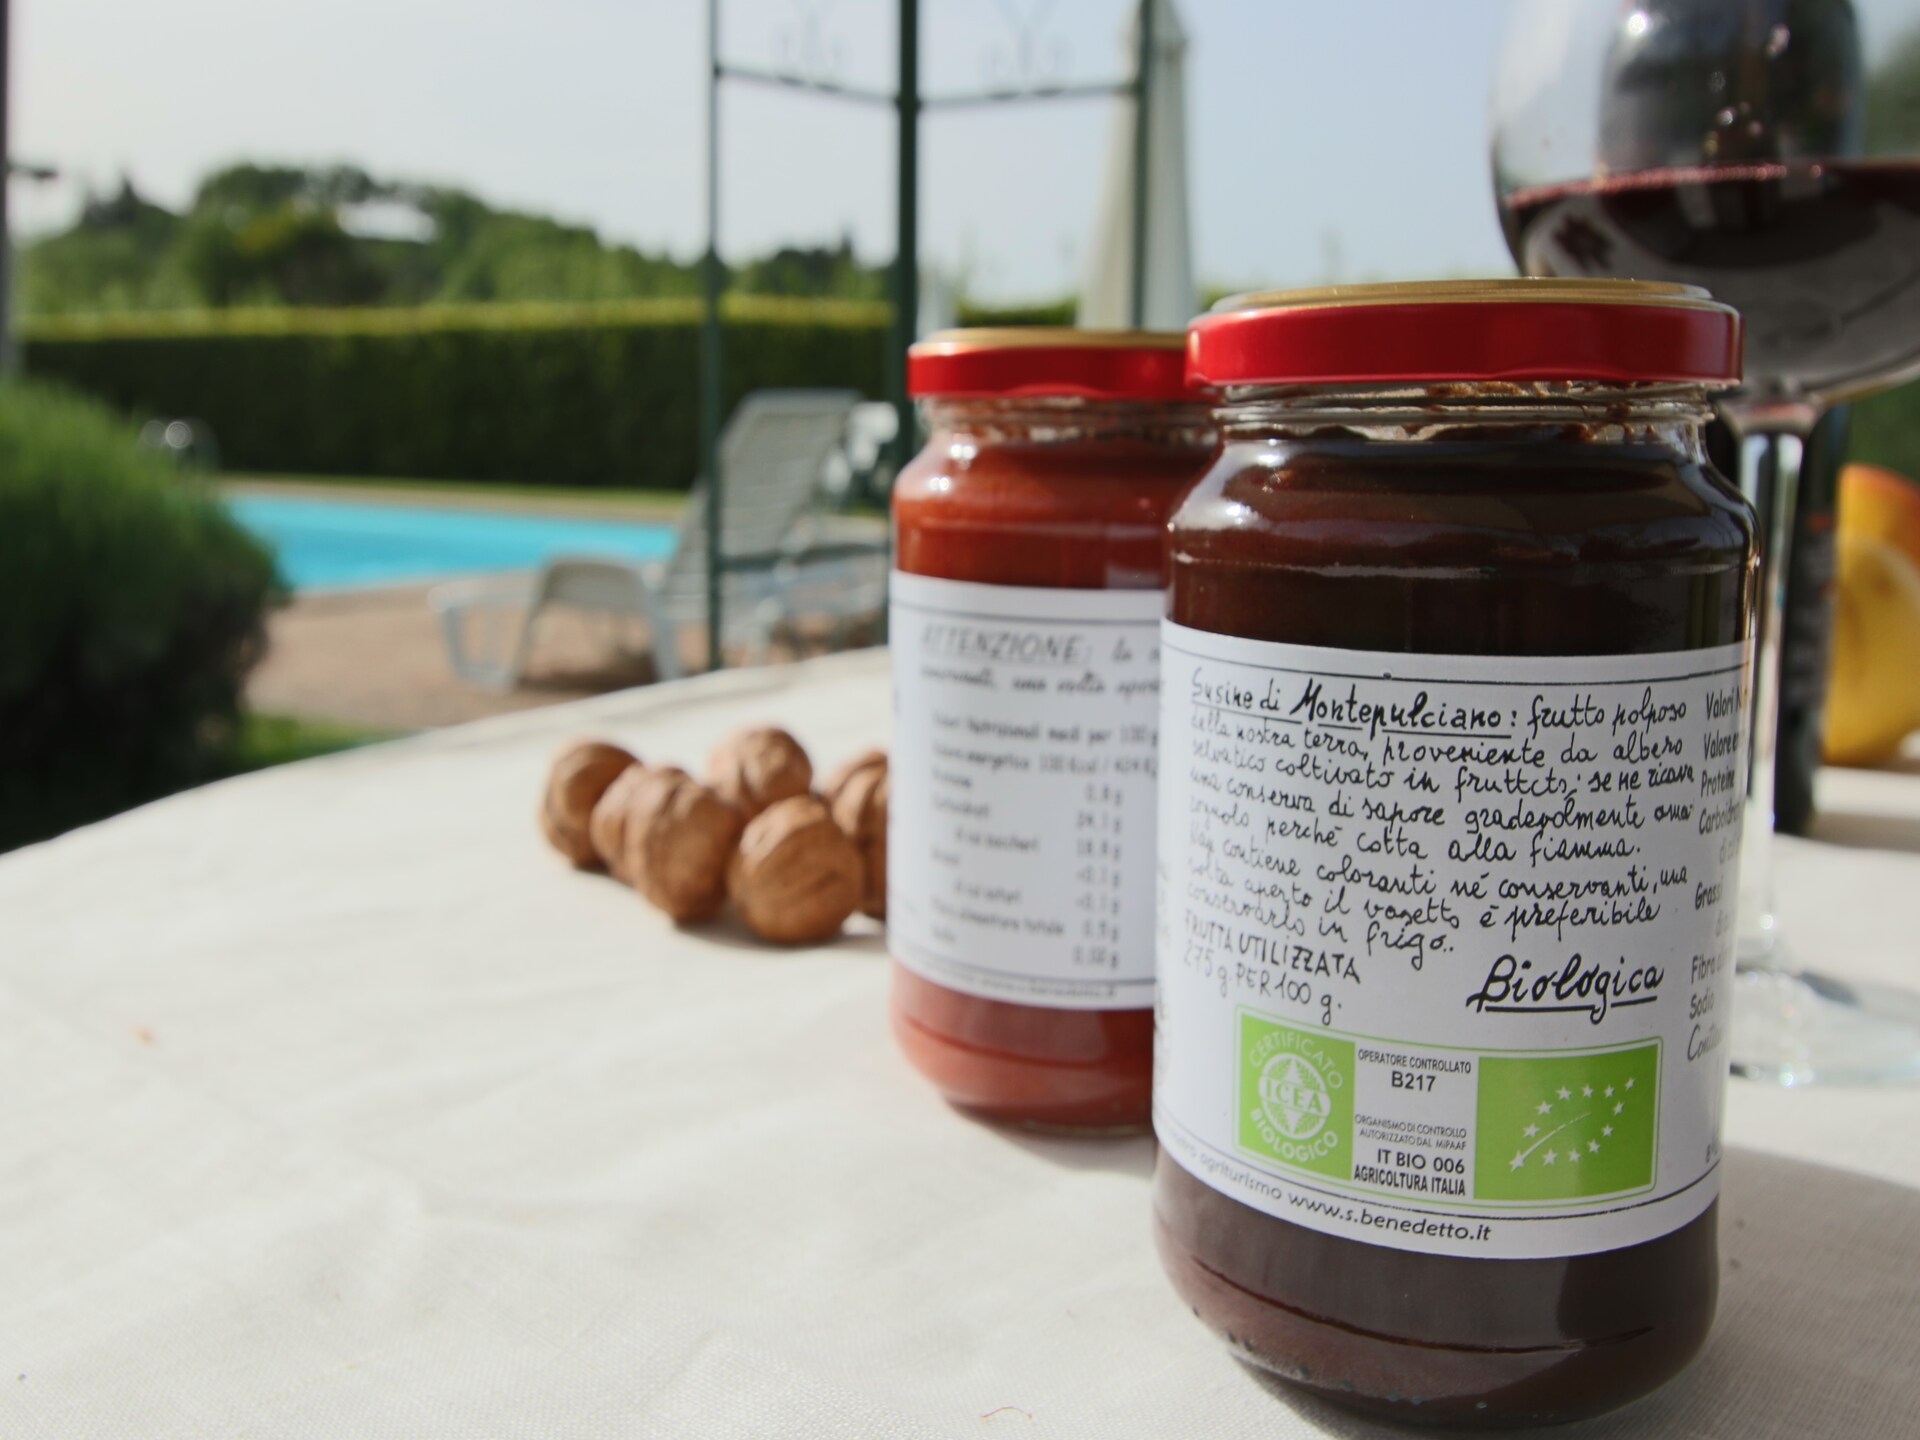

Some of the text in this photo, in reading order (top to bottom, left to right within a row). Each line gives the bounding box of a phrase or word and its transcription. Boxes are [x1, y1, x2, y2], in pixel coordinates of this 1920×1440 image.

[1191, 666, 1253, 710] Susine
[1259, 678, 1280, 711] di
[1527, 694, 1605, 739] frutto
[1706, 688, 1734, 720] Valori
[1236, 718, 1295, 749] nostra
[1304, 726, 1369, 759] terra,
[1383, 735, 1545, 767] proveniente
[1560, 731, 1598, 763] da
[1613, 730, 1683, 763] albero
[1704, 728, 1731, 761] Valore
[1275, 753, 1395, 789] coltivato
[1403, 767, 1440, 794] in
[1701, 765, 1735, 798] Proteine
[1190, 767, 1220, 791] una
[1226, 777, 1316, 812] conserva
[1328, 789, 1354, 817] di
[1361, 799, 1445, 833] sapore
[1222, 835, 1301, 877] contiene
[1316, 854, 1437, 895] coloranti
[1660, 864, 1688, 888] una
[1356, 826, 1429, 860] cotta
[1448, 832, 1516, 861] alla
[1530, 830, 1641, 868] fiamma.
[1184, 907, 1233, 954] FRUTTA
[1244, 879, 1313, 911] aperto
[1324, 885, 1351, 915] il
[1503, 897, 1661, 943] preferibile
[1318, 918, 1348, 943] in
[1465, 953, 1664, 1025] Biologica
[1250, 1030, 1343, 1090] CERTIFICATO
[1358, 1048, 1472, 1074] OPERATORE CONTROLLATO
[1265, 1078, 1323, 1115] ICEA
[1391, 1070, 1436, 1093] B217
[1250, 1107, 1339, 1164] BIOLOGICO
[1354, 1113, 1406, 1132] ORGANISMO
[1417, 1123, 1467, 1139] CONTROLLO
[1353, 1163, 1466, 1197] AGRICOLTURA ITALIA
[1377, 1148, 1466, 1175] IT BIO 006
[1199, 1152, 1492, 1242] agriturismo www.s.benedetto.it
